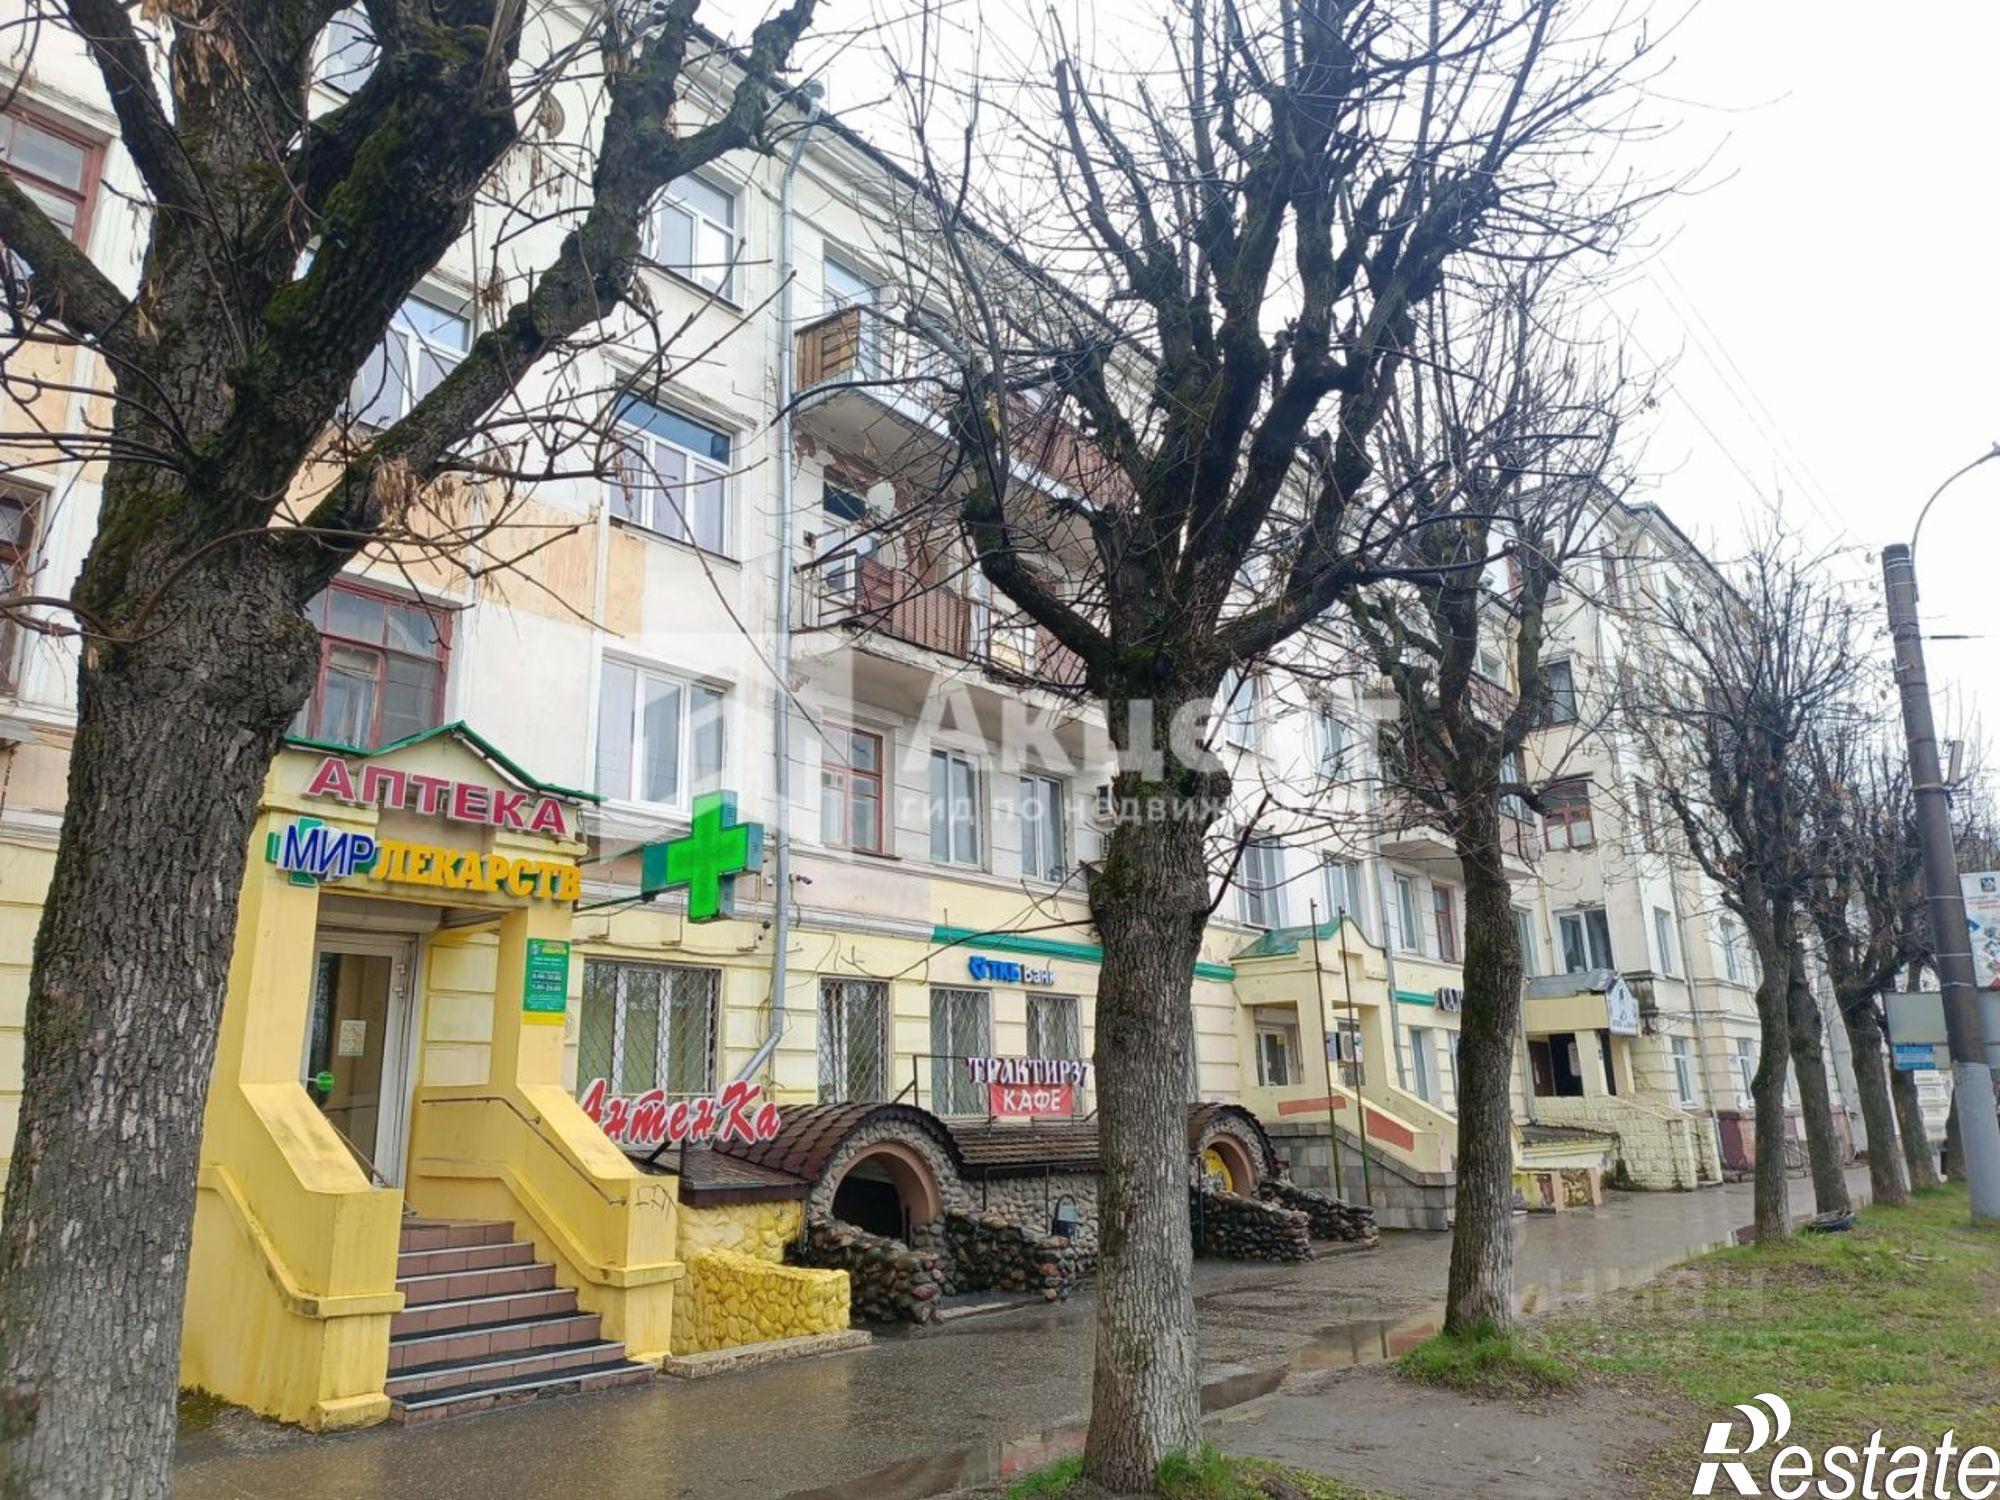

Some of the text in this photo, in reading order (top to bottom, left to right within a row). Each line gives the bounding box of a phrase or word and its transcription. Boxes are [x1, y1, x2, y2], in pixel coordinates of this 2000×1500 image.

[306, 756, 569, 837] АПТЕКА
[279, 823, 583, 902] МИР ЛЕКАРСТВ
[1002, 1088, 1062, 1113] КАФЕ
